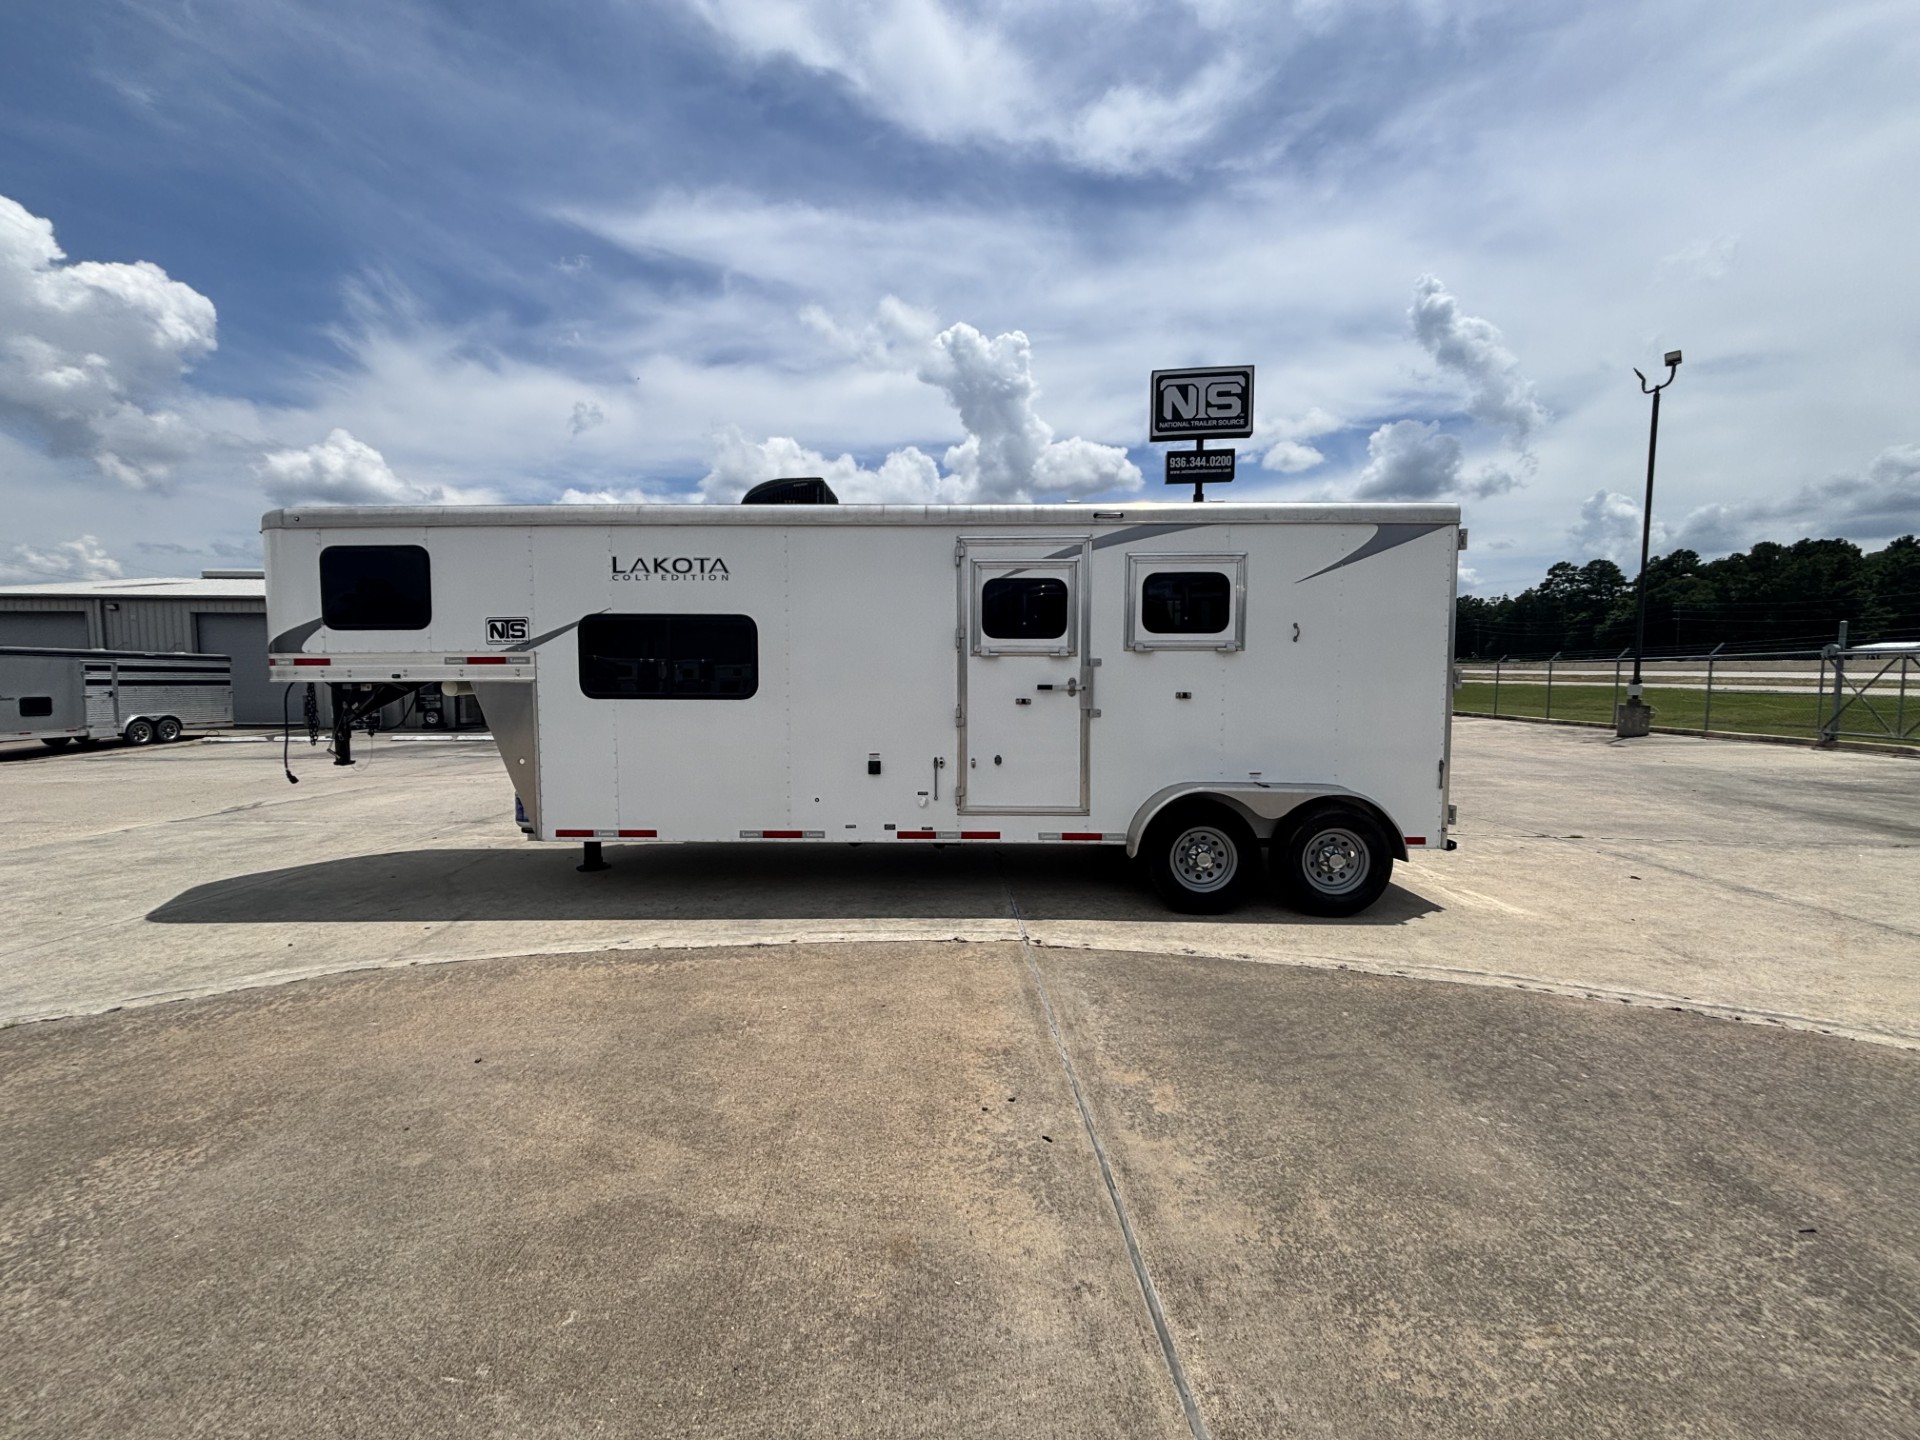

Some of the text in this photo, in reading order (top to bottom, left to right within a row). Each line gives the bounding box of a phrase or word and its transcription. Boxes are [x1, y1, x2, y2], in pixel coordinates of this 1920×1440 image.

[1160, 375, 1246, 420] NTS
[1169, 456, 1232, 468] 936.344.0200
[612, 556, 729, 574] LAKOTA
[488, 619, 527, 639] NTS
